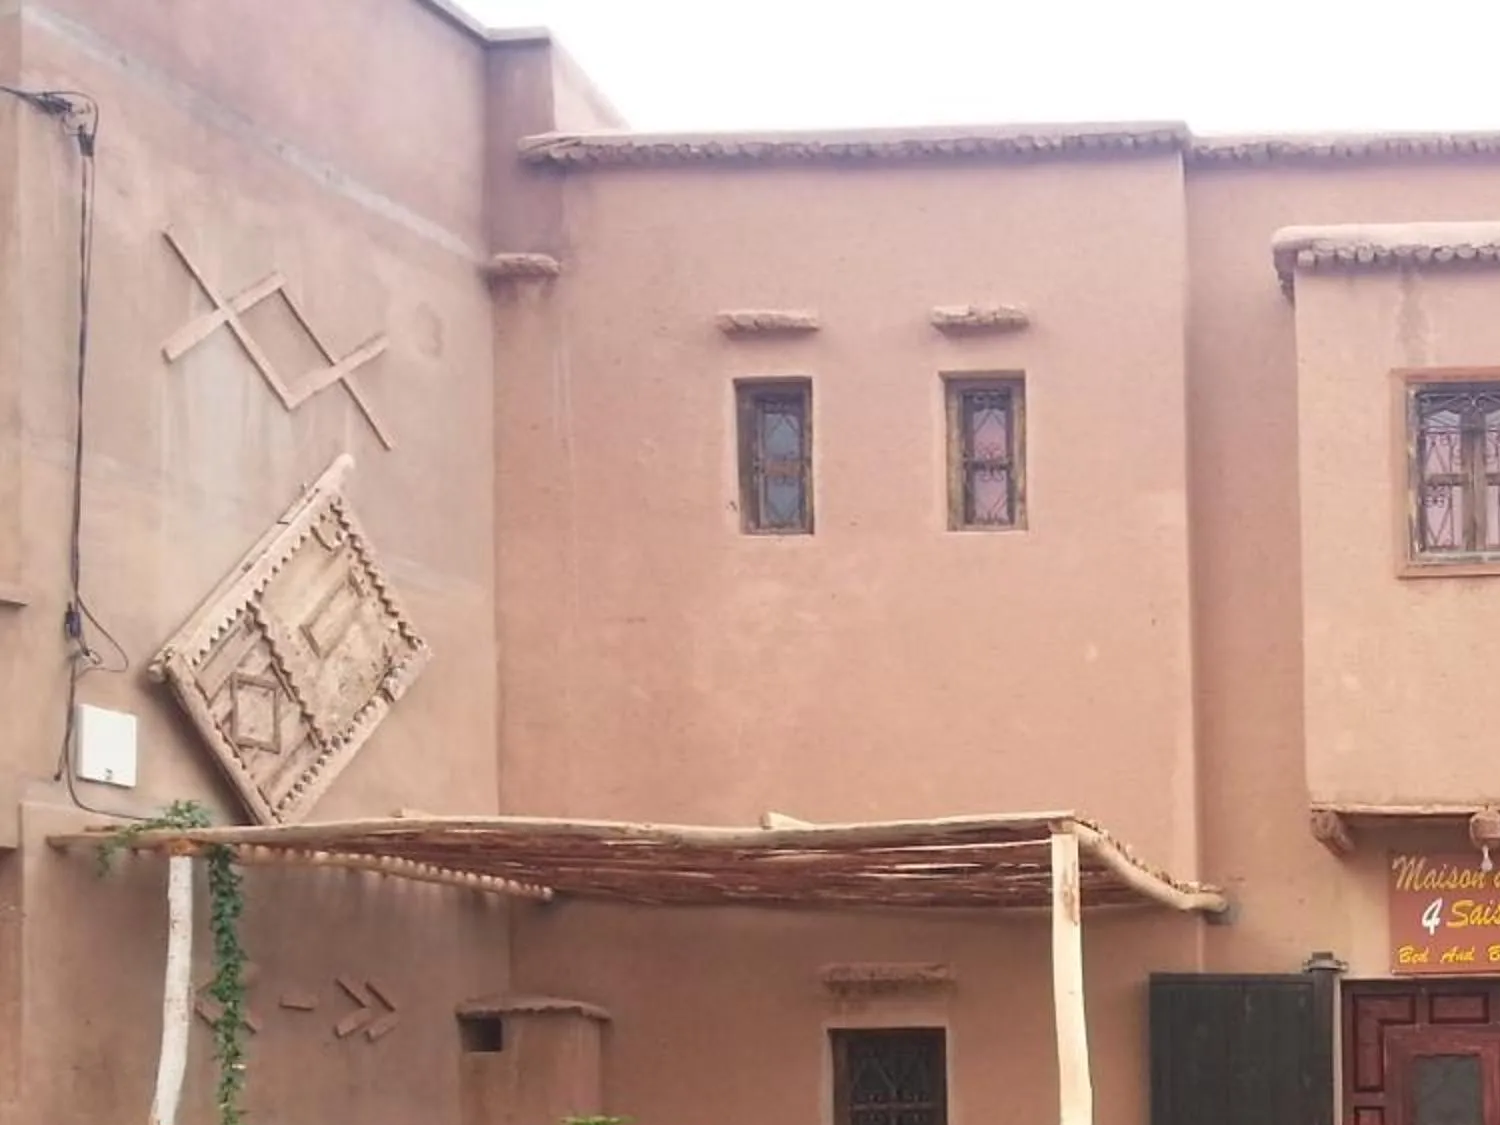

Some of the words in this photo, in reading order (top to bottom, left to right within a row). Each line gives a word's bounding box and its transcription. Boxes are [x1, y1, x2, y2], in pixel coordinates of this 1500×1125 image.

[1392, 854, 1485, 891] Maison
[1422, 897, 1443, 935] 4
[1440, 946, 1475, 963] And
